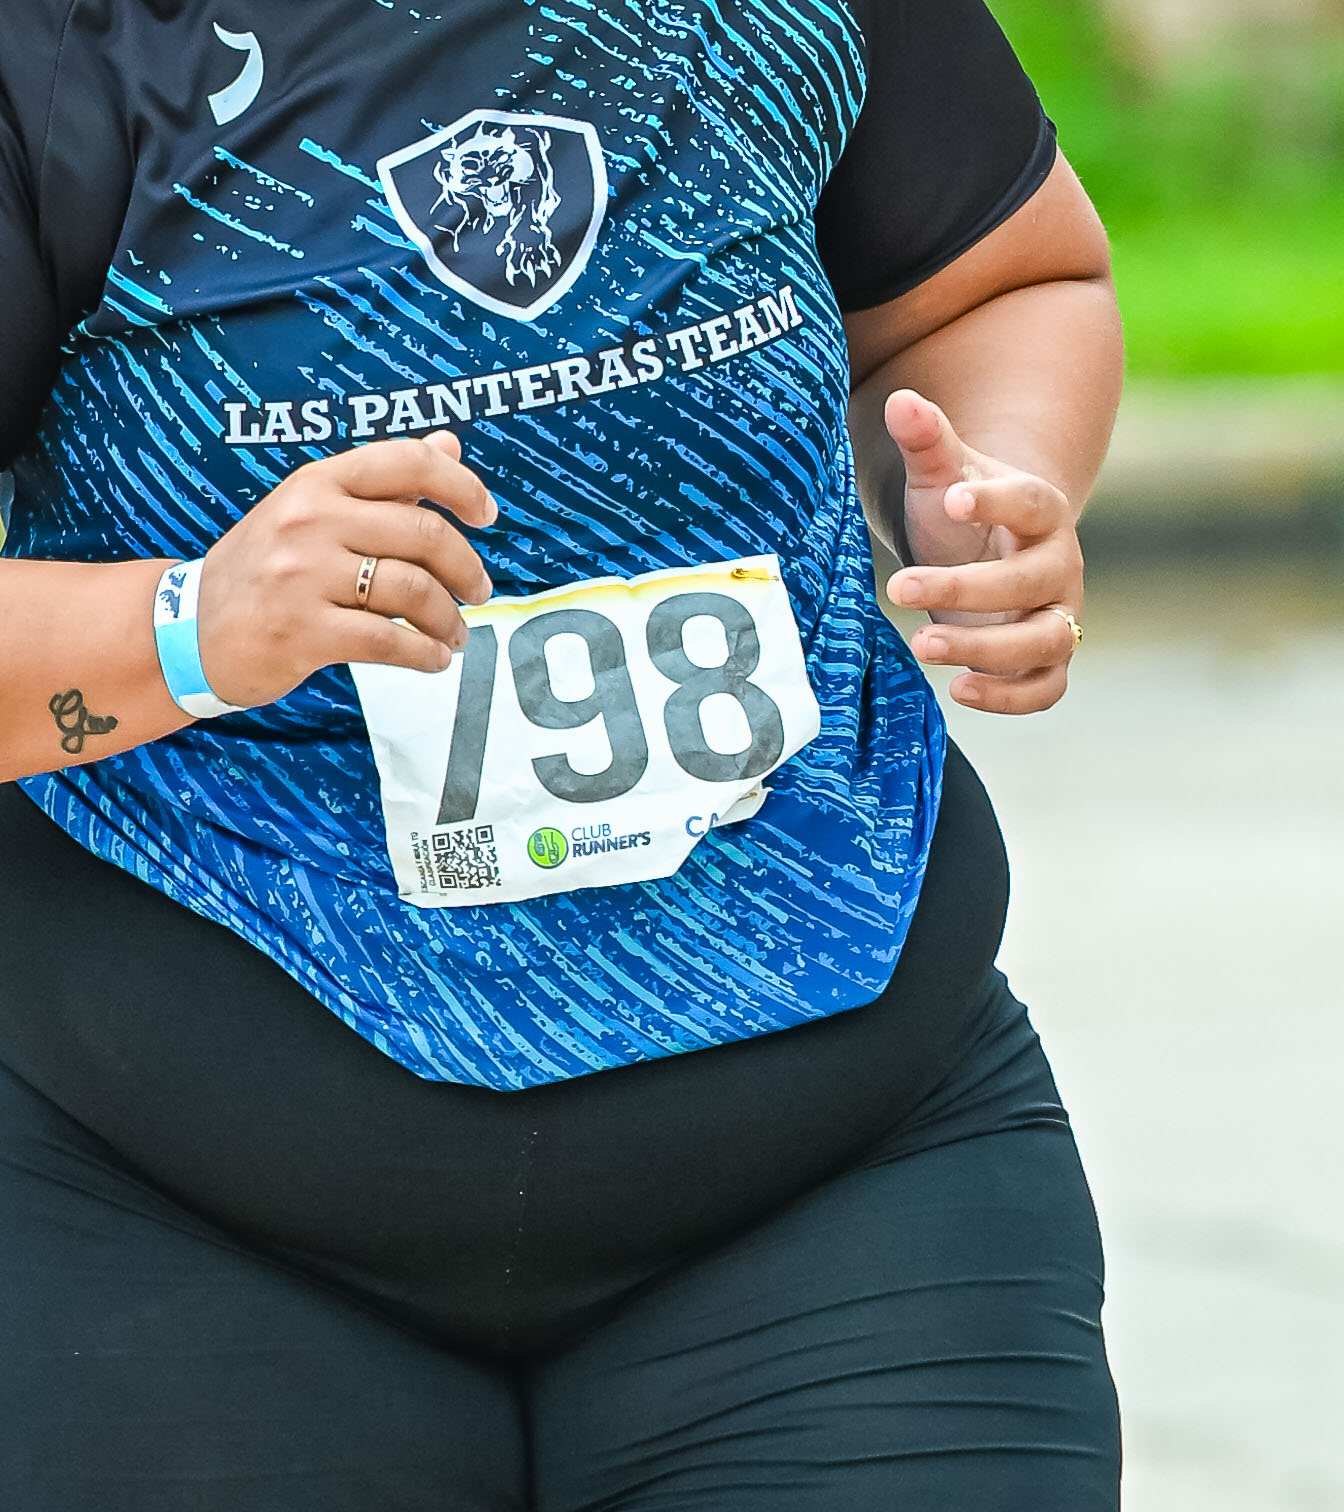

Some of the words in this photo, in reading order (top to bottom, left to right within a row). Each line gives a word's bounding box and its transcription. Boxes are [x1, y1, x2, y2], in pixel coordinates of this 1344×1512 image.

[223, 398, 333, 444] LAS
[348, 338, 665, 438] PANTERAS
[665, 284, 804, 372] TEAM
[435, 591, 785, 826] 798
[571, 823, 612, 842] CLUB
[571, 831, 652, 858] RUNNER'S
